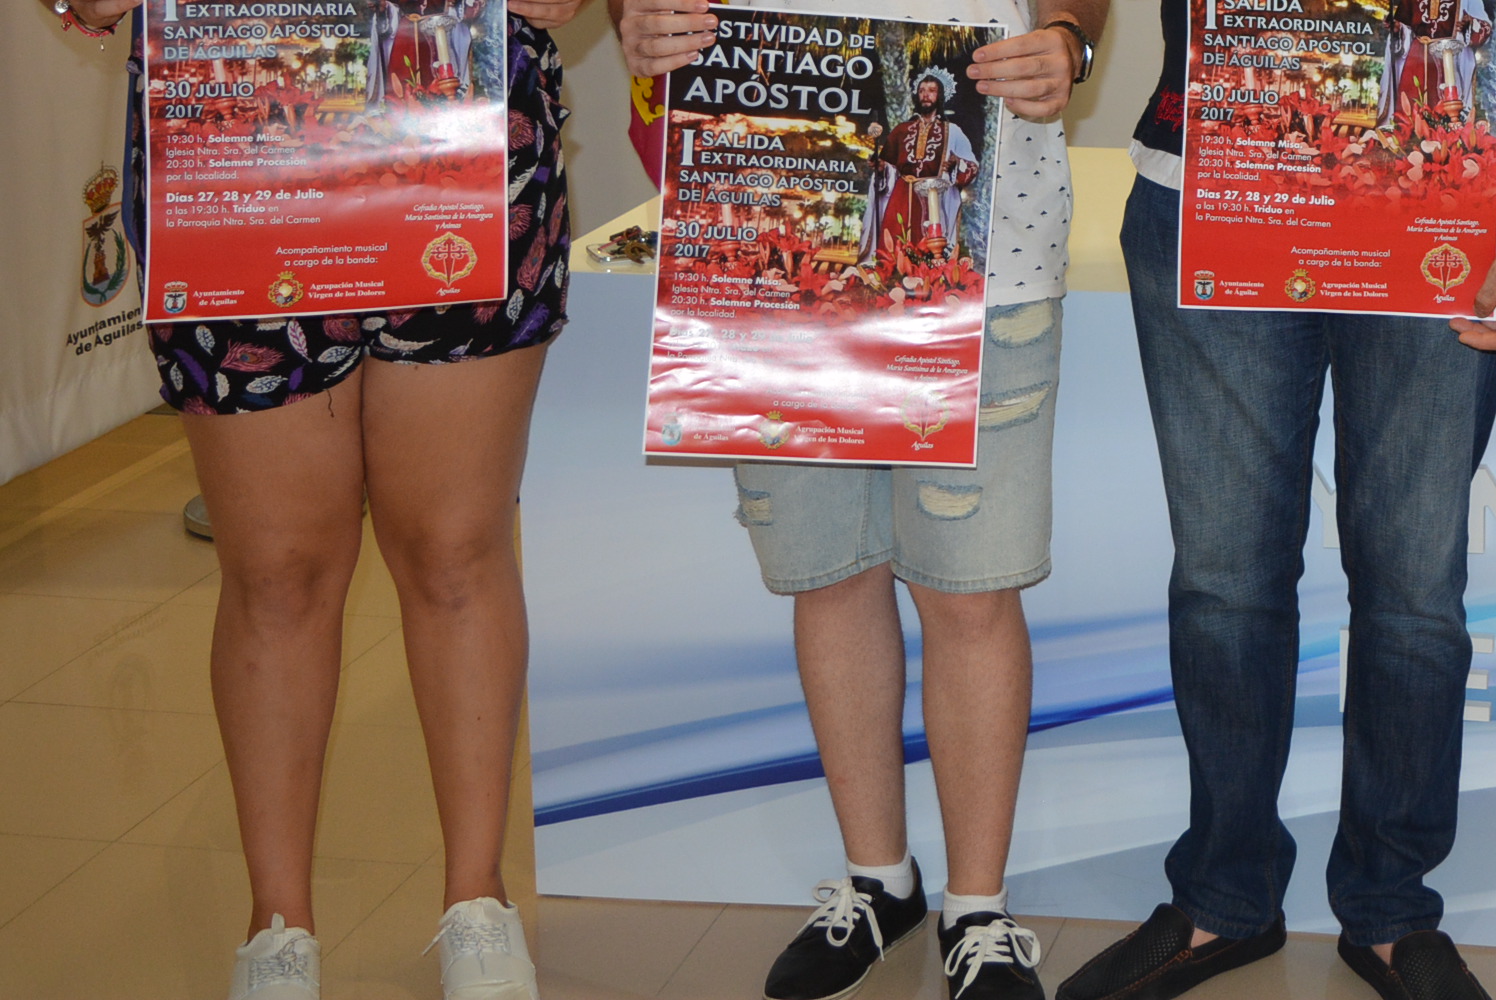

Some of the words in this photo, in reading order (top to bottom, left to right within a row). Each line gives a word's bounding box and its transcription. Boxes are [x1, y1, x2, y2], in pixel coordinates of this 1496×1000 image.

[185, 3, 357, 17] EXTRAORDINARIA
[164, 25, 267, 39] SANTIAGO
[272, 21, 360, 37] APÓSTOL
[1223, 15, 1373, 35] EXTRAORDINARIA
[713, 20, 842, 46] STIVIDAD
[849, 35, 875, 49] DE
[164, 47, 188, 59] DE
[194, 42, 277, 59] ÁGUILAS
[1204, 33, 1293, 51] SANTIAGO
[1297, 37, 1375, 55] APÓSTOL
[1203, 53, 1224, 65] DE
[1229, 51, 1300, 70] ÁGUILAS
[165, 81, 190, 98] 30
[196, 83, 254, 98] JULIO
[683, 75, 871, 114] APÓSTOL
[1202, 85, 1224, 102] 30
[1228, 90, 1279, 105] JULIO
[165, 105, 204, 118] 2017
[1201, 107, 1234, 121] 2017
[701, 131, 784, 151] SALIDA
[700, 151, 857, 173] EXTRAORDINARIA
[680, 170, 774, 187] SANTIAGO
[777, 175, 858, 192] APÓSTOL
[198, 192, 219, 203] 27,
[223, 192, 239, 202] 28
[244, 194, 251, 203] y
[255, 191, 272, 201] 29
[275, 189, 291, 200] de
[295, 188, 324, 200] Julio
[678, 189, 700, 202] DE
[705, 187, 781, 207] ÁGUILAS
[1224, 191, 1242, 202] 27,
[1245, 192, 1260, 202] 28
[1264, 195, 1271, 204] y
[1274, 193, 1288, 203] 29
[1292, 194, 1306, 204] de
[1309, 195, 1335, 206] Julio
[676, 221, 700, 238] 30
[704, 226, 757, 242] JULIO
[674, 243, 710, 258] 2017
[1361, 249, 1390, 257] musical
[671, 296, 698, 305] 20:30
[700, 297, 709, 306] h.
[710, 298, 751, 307] Solemne
[66, 307, 141, 346] Ayuntamien
[75, 342, 92, 356] de
